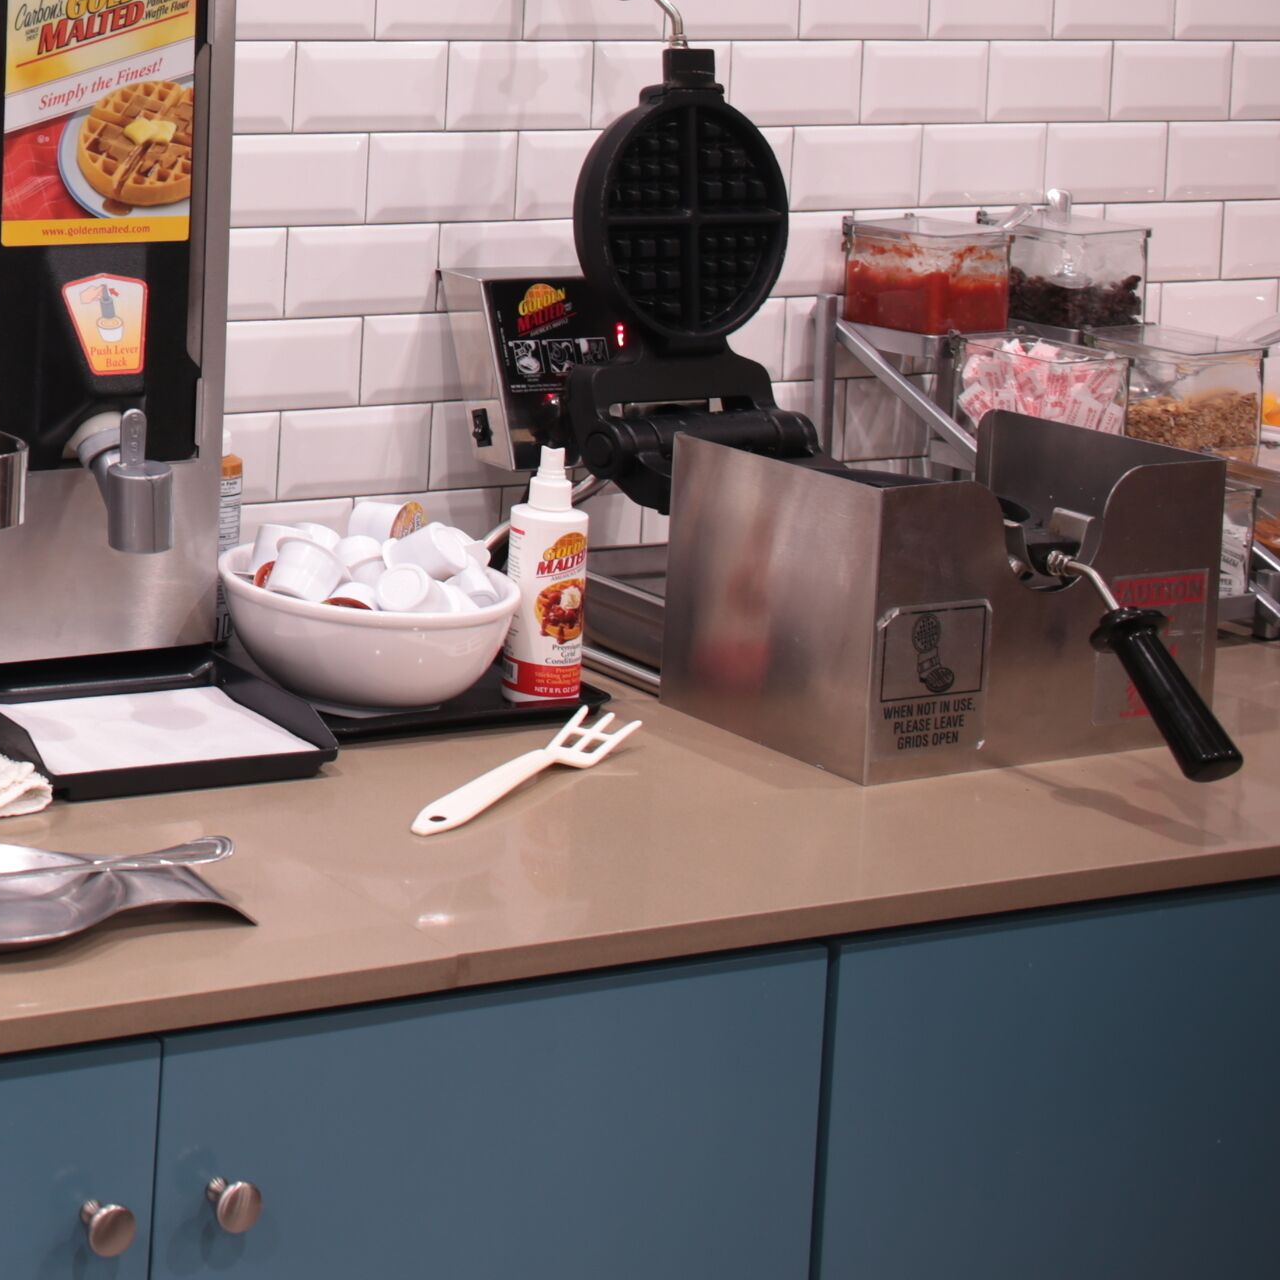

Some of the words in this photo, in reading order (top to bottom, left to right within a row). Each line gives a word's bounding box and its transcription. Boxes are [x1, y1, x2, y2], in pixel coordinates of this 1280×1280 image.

[145, 5, 169, 21] Waffle
[170, 0, 190, 13] Flour
[37, 0, 145, 55] MALTED
[38, 82, 88, 111] Simply
[90, 75, 113, 93] the
[115, 57, 163, 85] Finest!
[41, 223, 151, 237] www.goldenmalted.com
[518, 287, 566, 316] GOLDEN
[516, 302, 565, 333] MALTED
[90, 345, 112, 356] Push
[114, 344, 139, 355] Lever
[105, 357, 127, 368] Back
[560, 650, 576, 659] Grid
[534, 685, 548, 693] NET
[883, 704, 913, 720] WHEN
[916, 701, 937, 717] NOT
[940, 700, 950, 714] IN
[893, 718, 931, 735] PLEASE
[934, 714, 965, 730] LEAVE
[897, 733, 929, 750] GRIDS
[931, 731, 959, 746] OPEN
